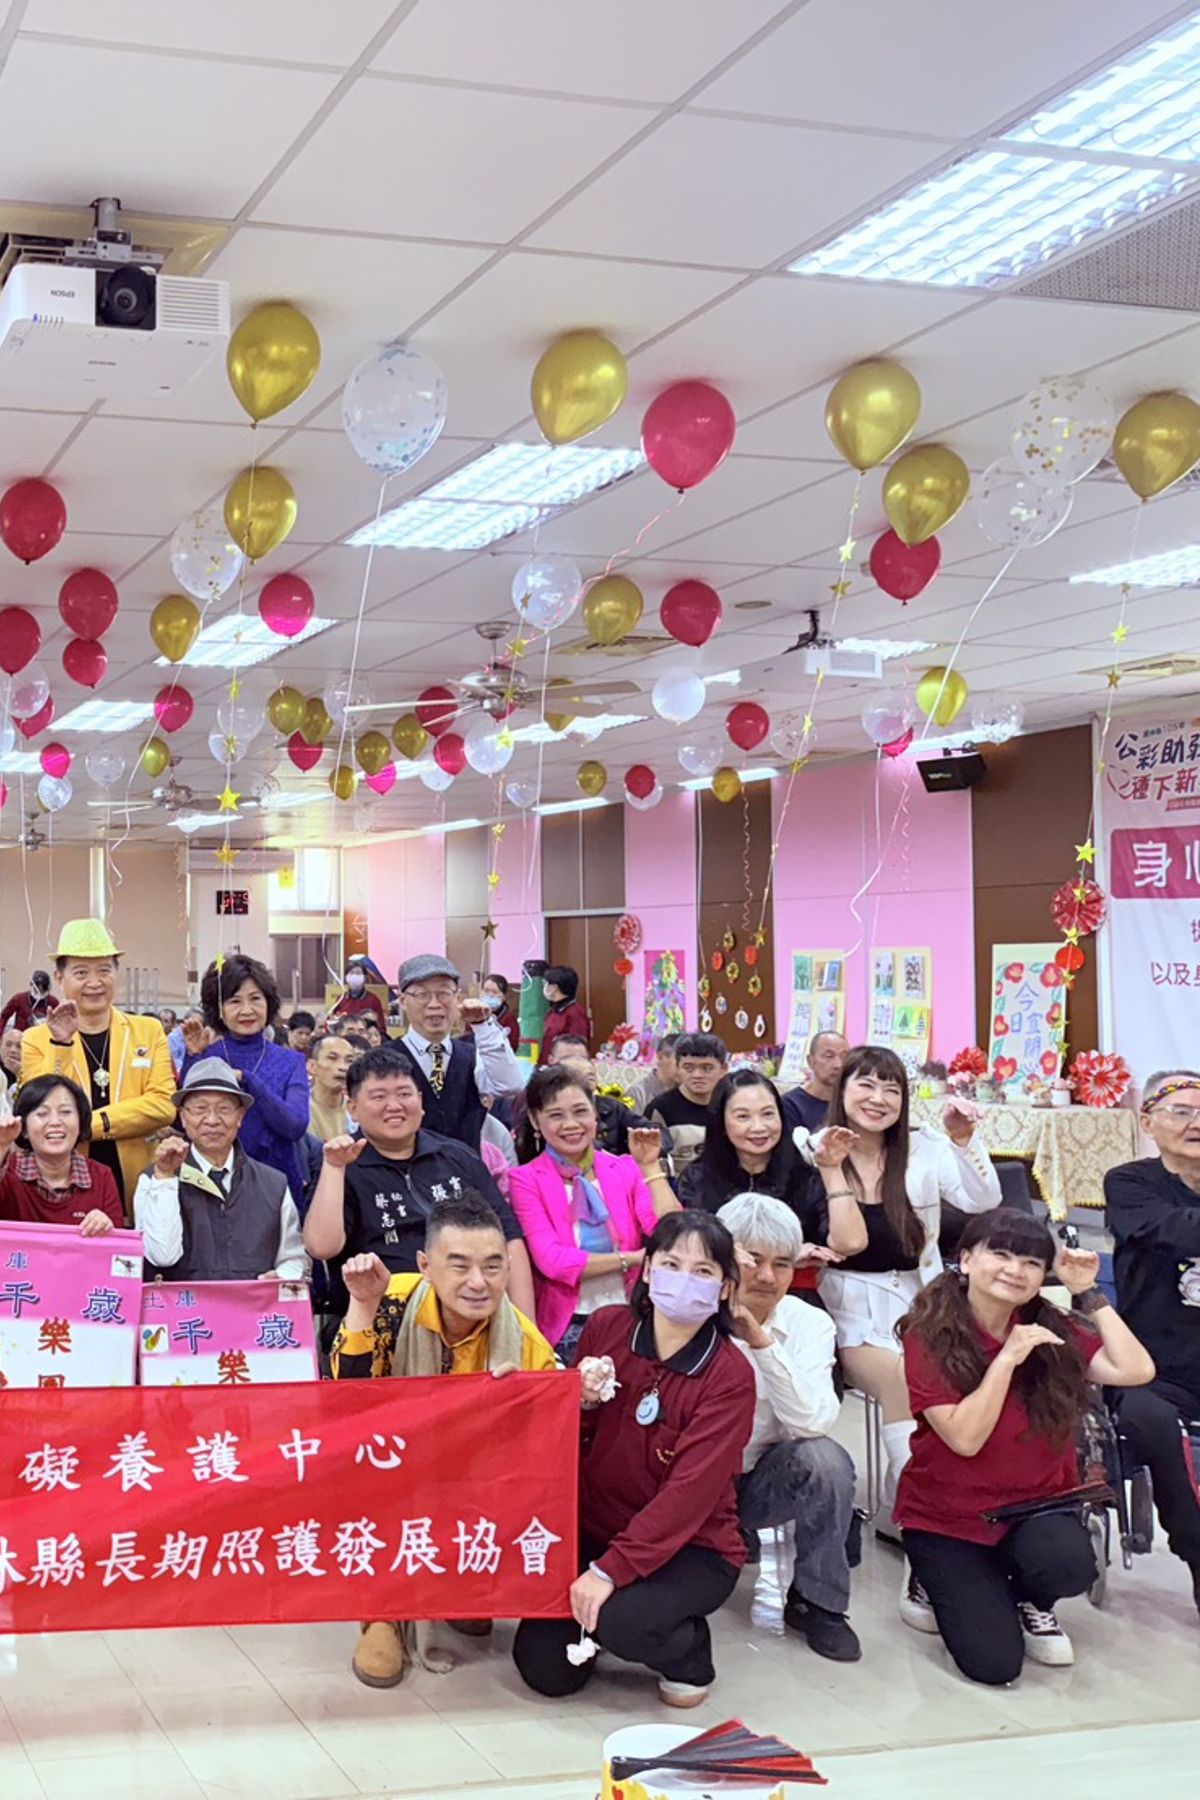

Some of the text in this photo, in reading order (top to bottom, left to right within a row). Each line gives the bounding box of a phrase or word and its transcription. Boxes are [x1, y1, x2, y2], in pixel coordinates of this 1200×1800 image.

[143, 1289, 197, 1310] 土庫
[172, 1314, 301, 1354] 千歲
[217, 1348, 253, 1385] 樂
